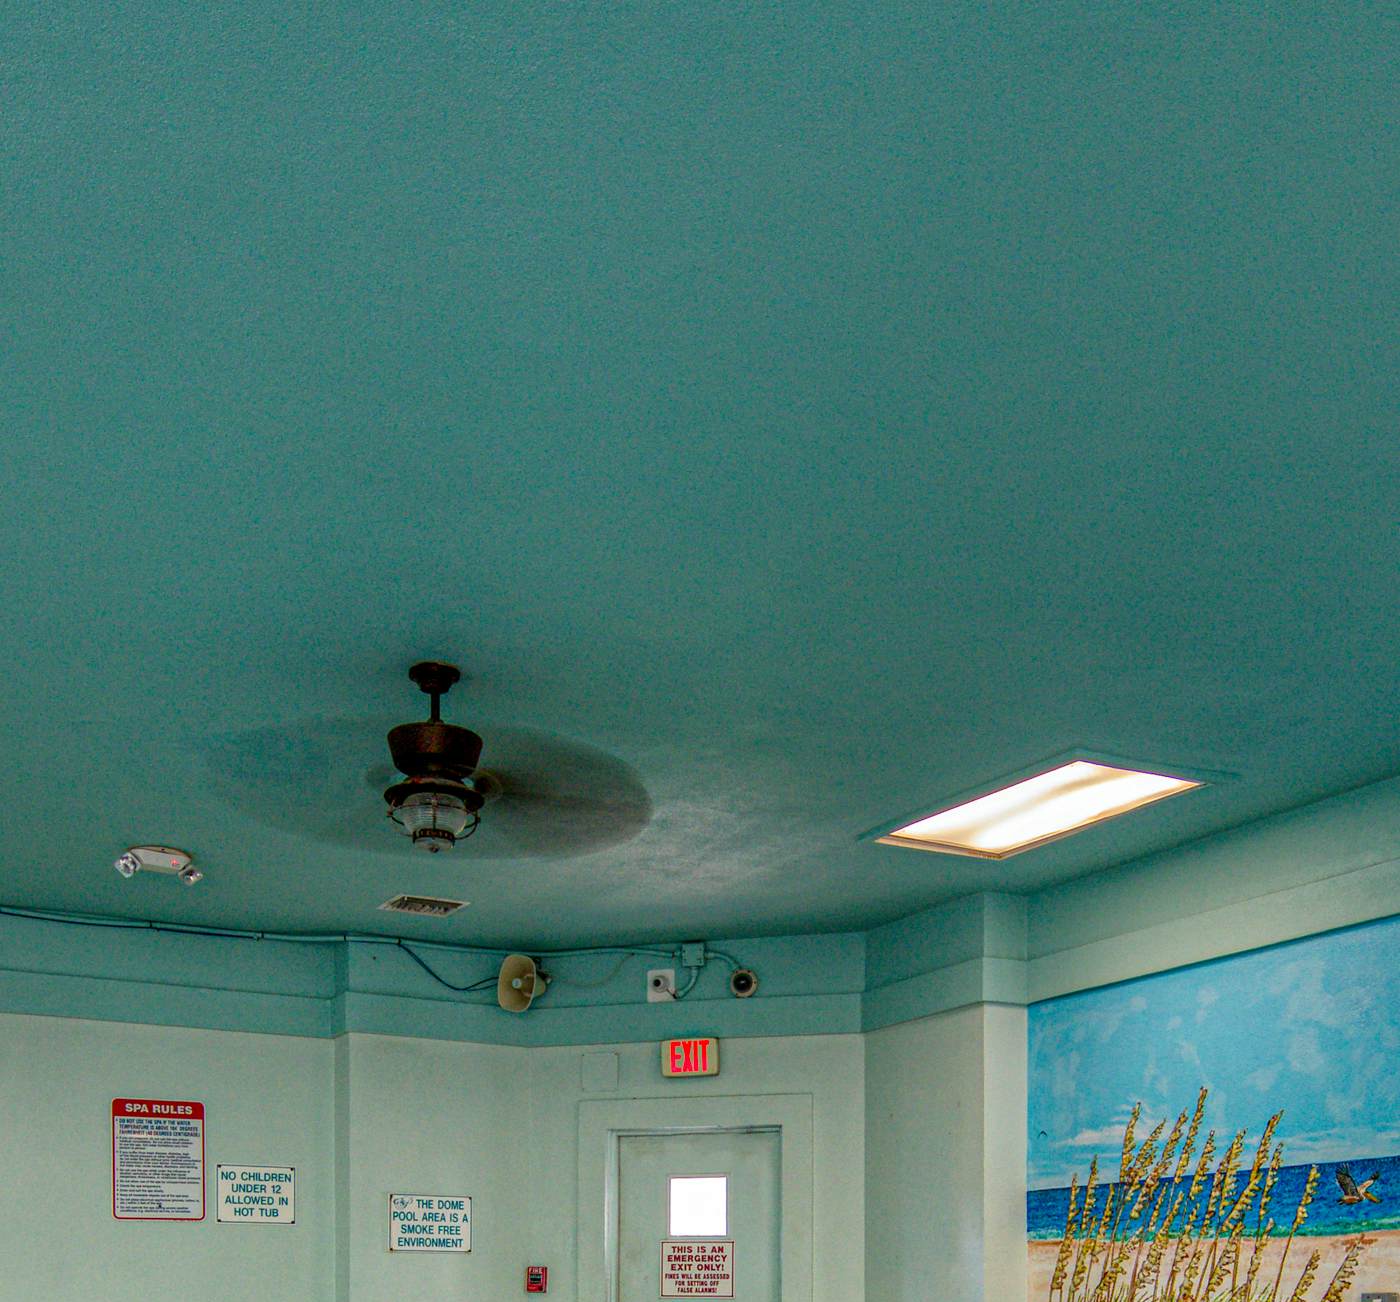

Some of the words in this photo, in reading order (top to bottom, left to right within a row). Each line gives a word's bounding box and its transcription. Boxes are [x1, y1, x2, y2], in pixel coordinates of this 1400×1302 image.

[670, 1039, 710, 1073] EXIT
[125, 1103, 149, 1113] SPA
[152, 1104, 193, 1115] RULES
[221, 1171, 237, 1181] NO
[241, 1172, 292, 1183] CHILDREN
[231, 1183, 267, 1193] UNDER
[271, 1185, 282, 1194] 12
[225, 1195, 275, 1205] ALLOWED
[278, 1197, 289, 1206] IN
[416, 1199, 434, 1209] THE
[437, 1200, 465, 1210] DOME
[234, 1207, 255, 1217] HOT
[259, 1208, 279, 1217] TUB
[393, 1211, 418, 1221] POOL
[421, 1212, 446, 1222] AREA
[449, 1213, 459, 1223] IS
[462, 1213, 469, 1223] A
[401, 1224, 434, 1235] SMOKE
[437, 1225, 461, 1236] FREE
[397, 1236, 464, 1248] ENVIRONMENT
